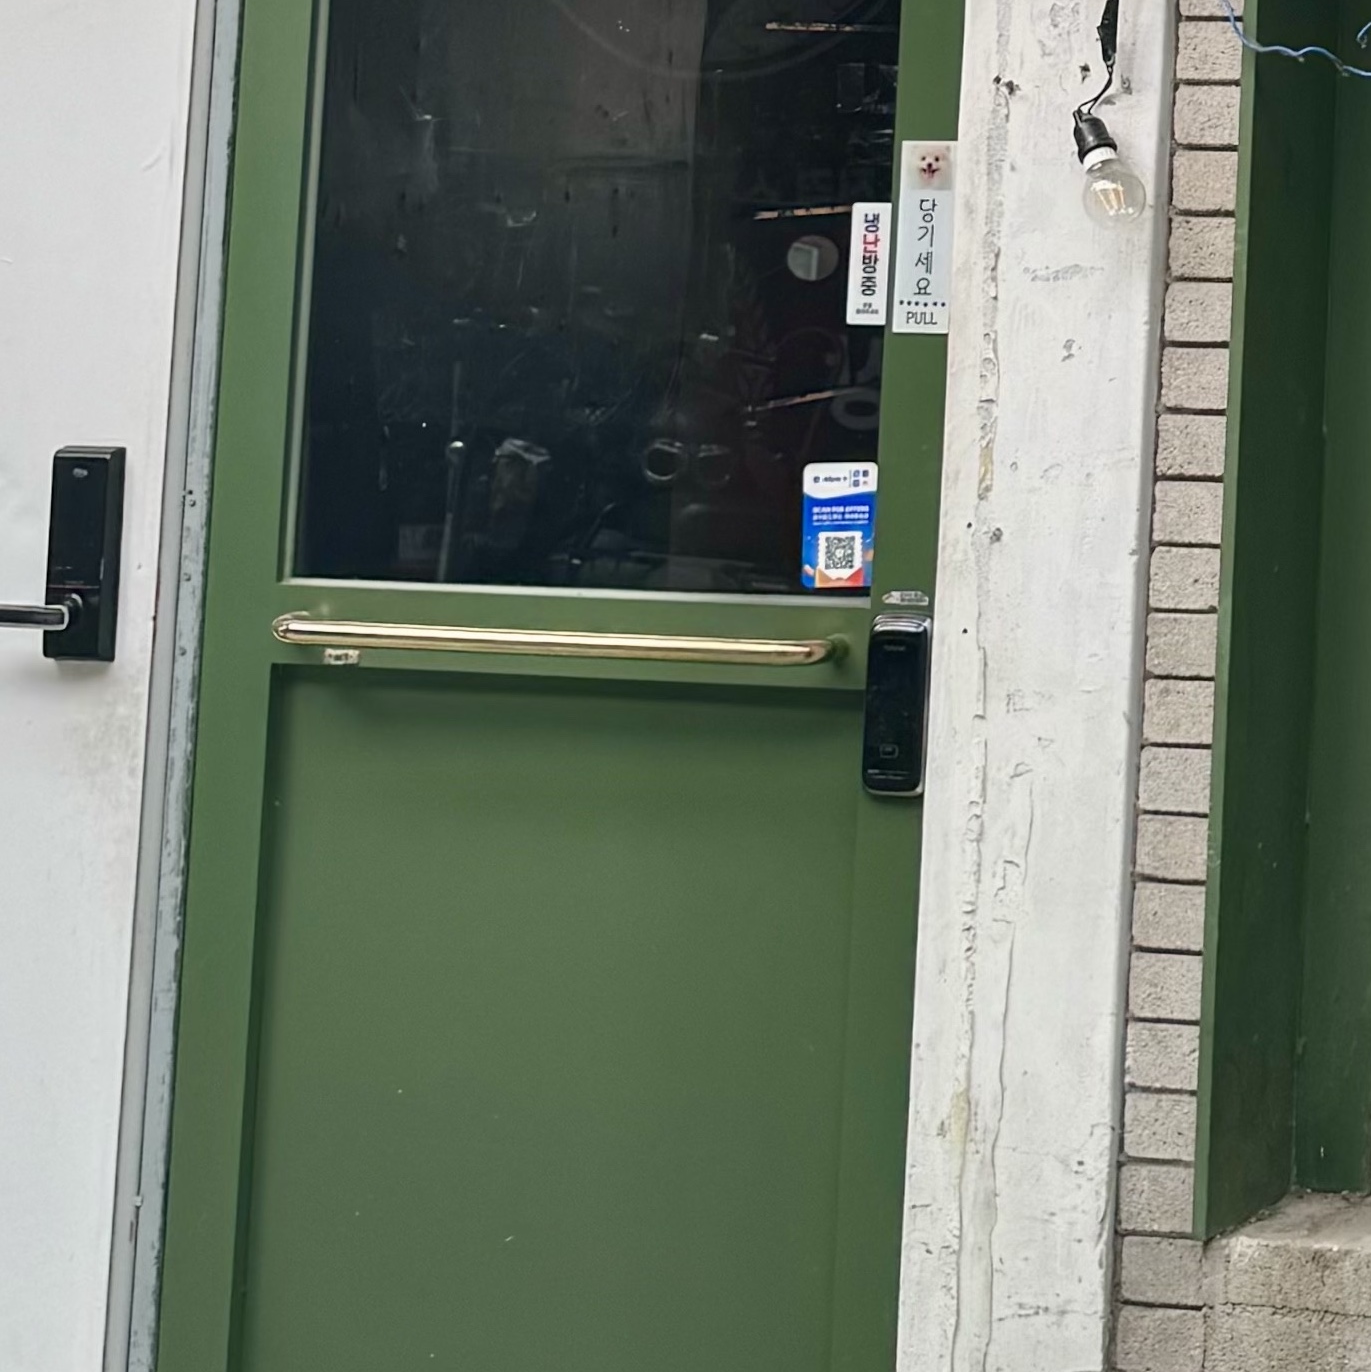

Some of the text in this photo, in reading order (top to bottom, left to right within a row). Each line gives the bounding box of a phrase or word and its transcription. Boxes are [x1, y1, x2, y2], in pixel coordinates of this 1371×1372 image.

[861, 212, 880, 296] 냉난방중
[913, 198, 938, 296] 당기세요
[906, 311, 938, 325] PULL
